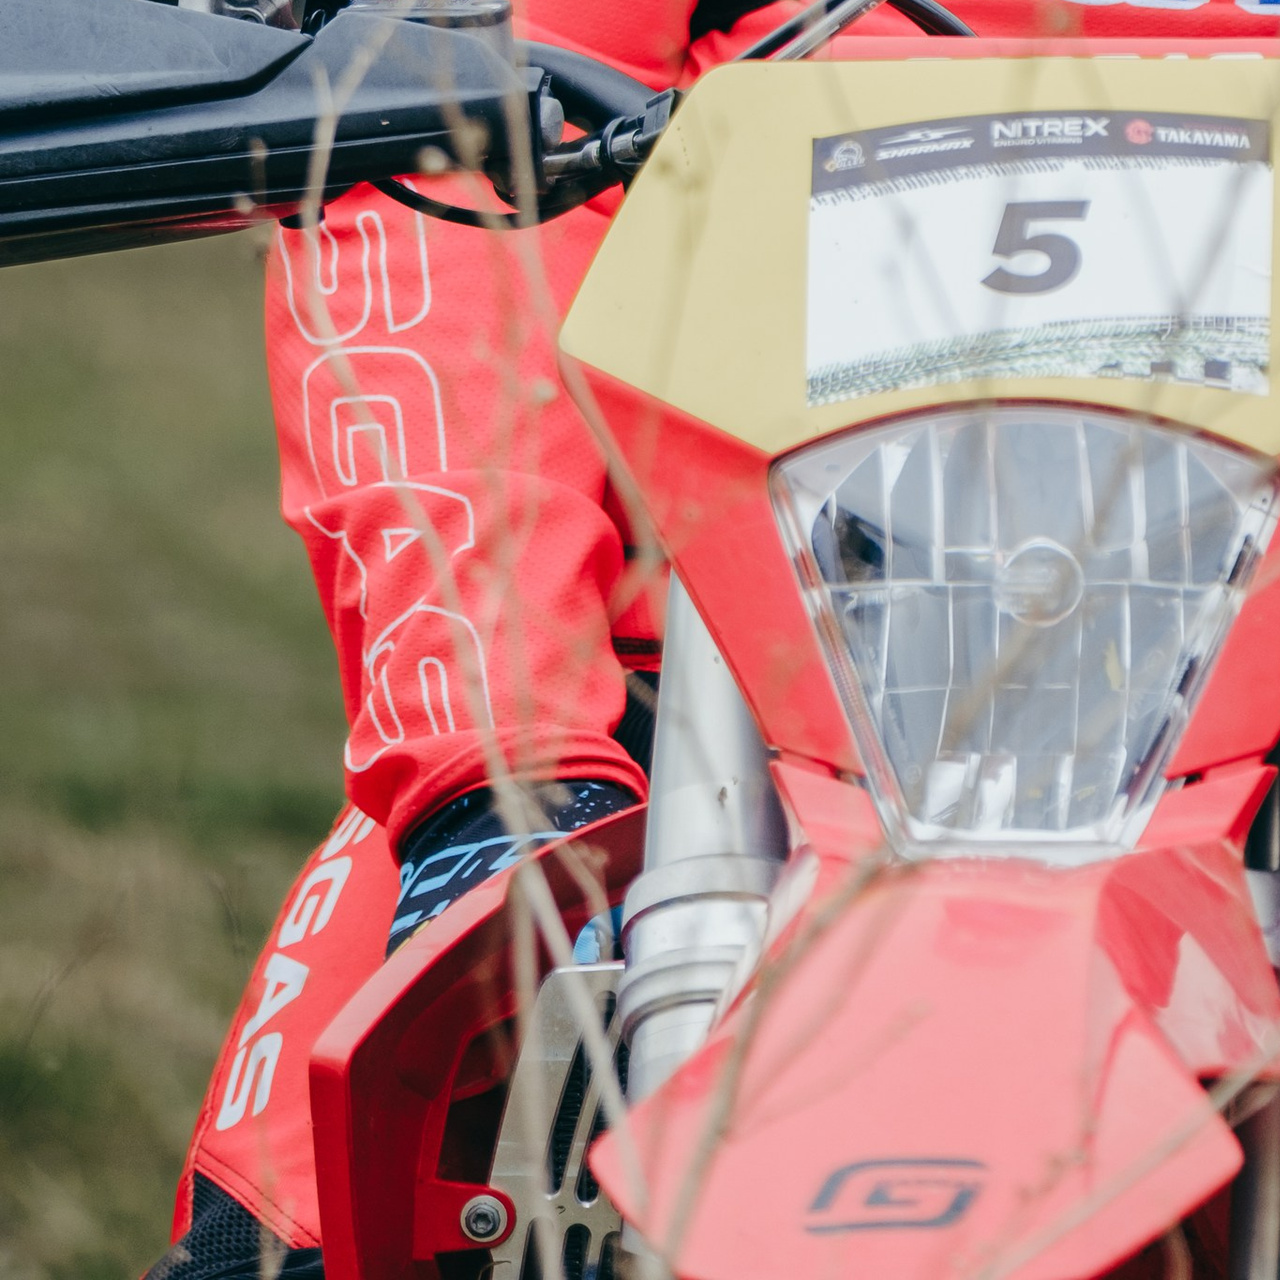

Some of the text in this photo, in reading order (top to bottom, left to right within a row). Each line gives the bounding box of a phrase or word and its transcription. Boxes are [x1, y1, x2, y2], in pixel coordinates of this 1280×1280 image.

[876, 137, 975, 161] SHARMAX
[992, 117, 1110, 139] NITREX
[1156, 126, 1250, 149] TAKAYAMA
[993, 137, 1035, 147] ENDURO
[981, 200, 1091, 296] 5
